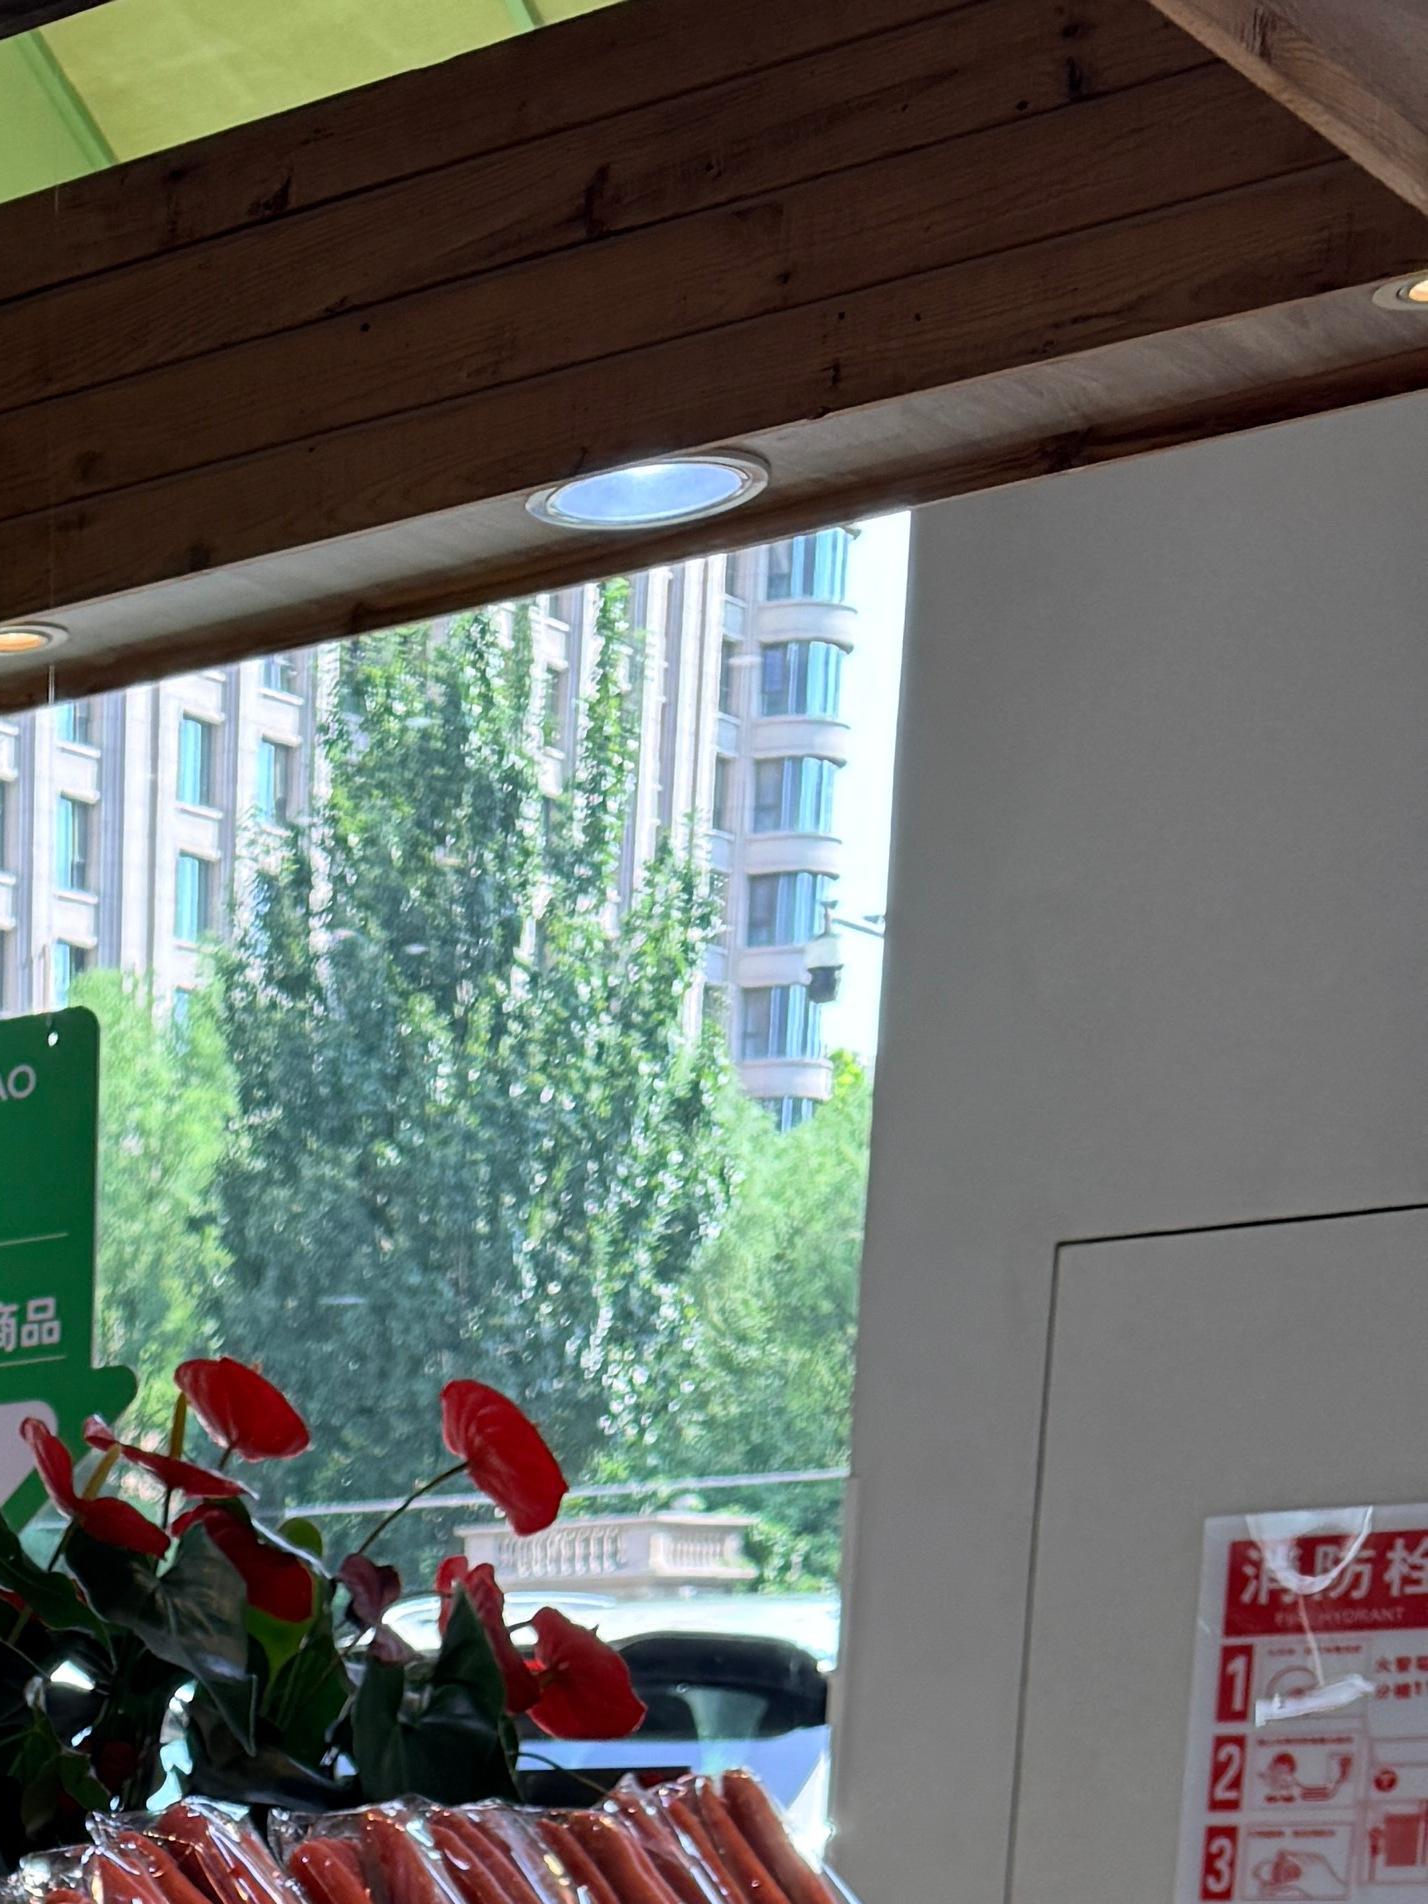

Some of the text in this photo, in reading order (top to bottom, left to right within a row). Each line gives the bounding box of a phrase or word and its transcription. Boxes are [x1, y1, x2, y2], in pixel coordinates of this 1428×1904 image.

[1225, 1655, 1248, 1712] 1
[1213, 1743, 1241, 1801] 2
[1205, 1835, 1232, 1893] 3
